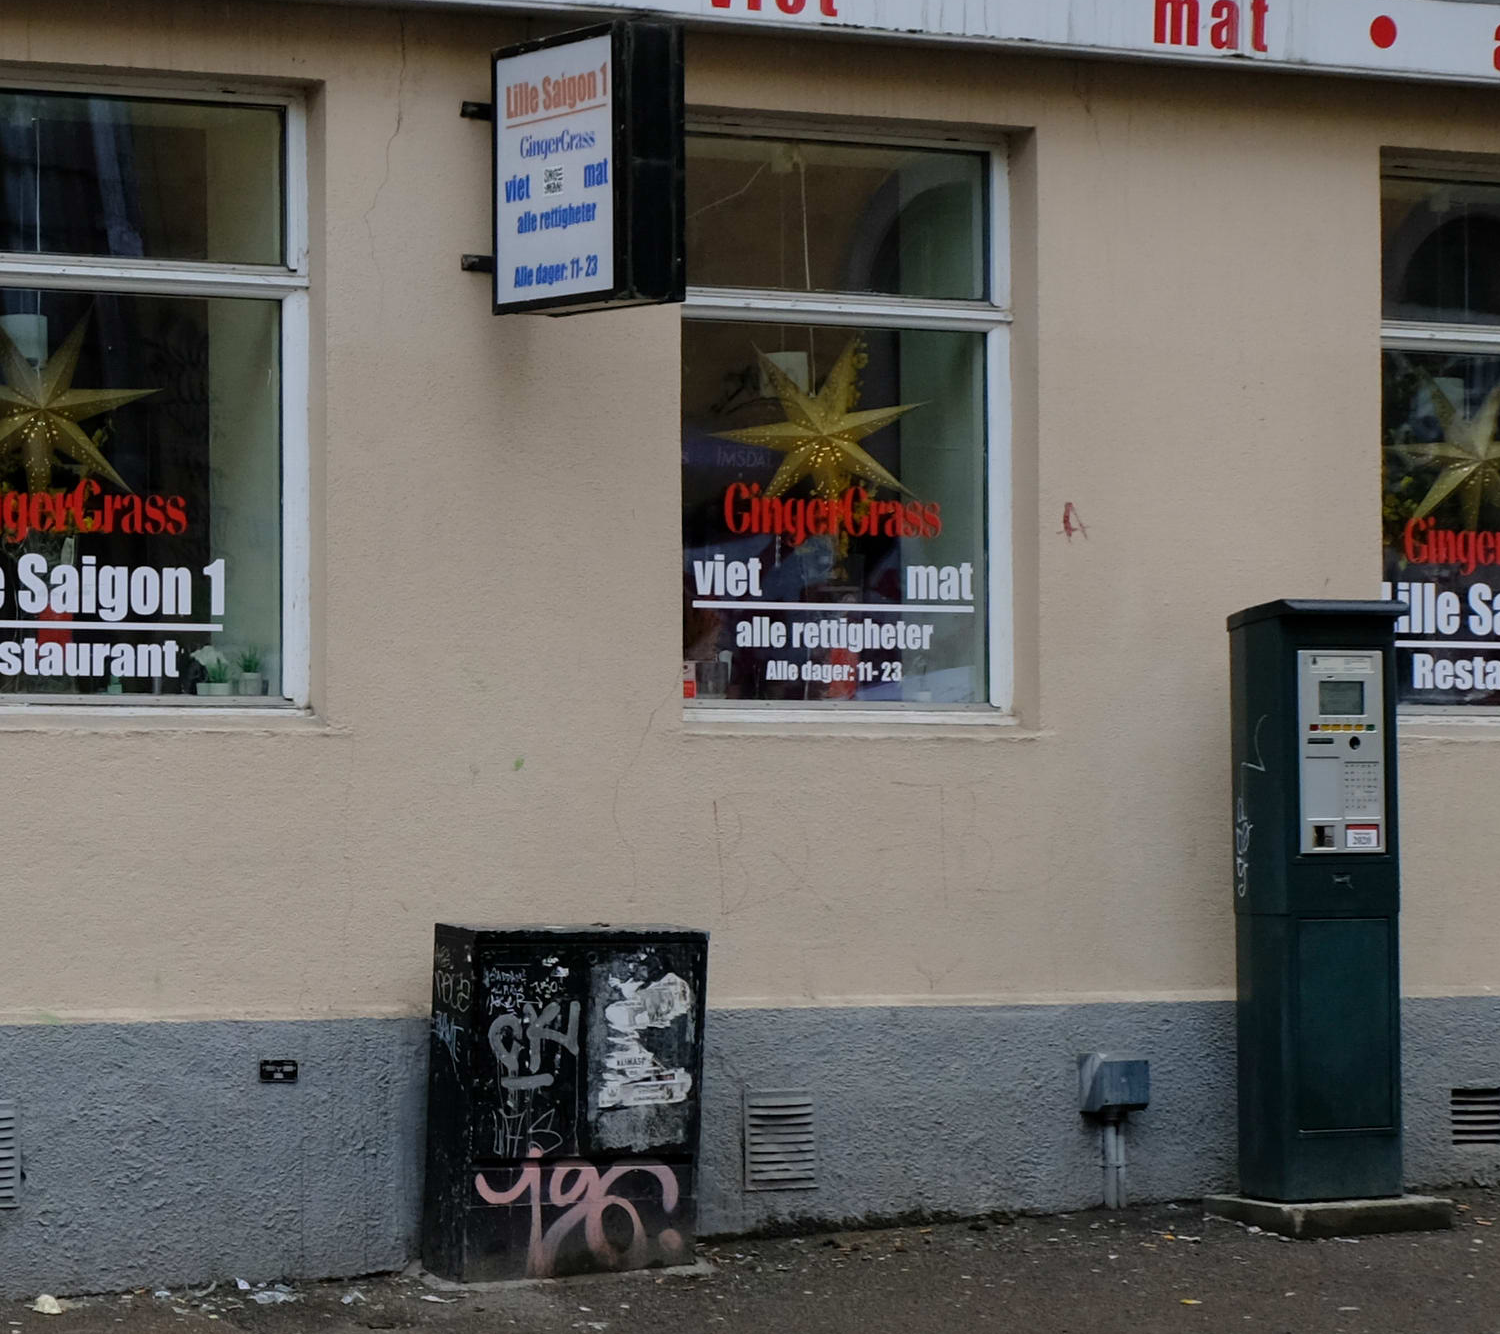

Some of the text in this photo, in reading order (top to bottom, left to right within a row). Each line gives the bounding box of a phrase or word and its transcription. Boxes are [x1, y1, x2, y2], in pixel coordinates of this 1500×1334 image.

[506, 61, 608, 120] Lille Saigon 1
[519, 129, 596, 161] GingerGrass
[505, 174, 531, 204] viet
[584, 158, 609, 189] mat
[517, 202, 597, 235] alle rettigheter
[514, 265, 534, 288] Alle
[536, 263, 568, 286] dager:
[585, 254, 598, 278] 23
[723, 482, 942, 547] GingerGrass
[17, 553, 193, 623] Saigon
[203, 558, 226, 617] 1
[693, 554, 975, 601] viet mat
[736, 616, 934, 653] alle rettigheter
[766, 660, 799, 682] Alle
[801, 660, 855, 683] dager:
[881, 661, 903, 683] 23
